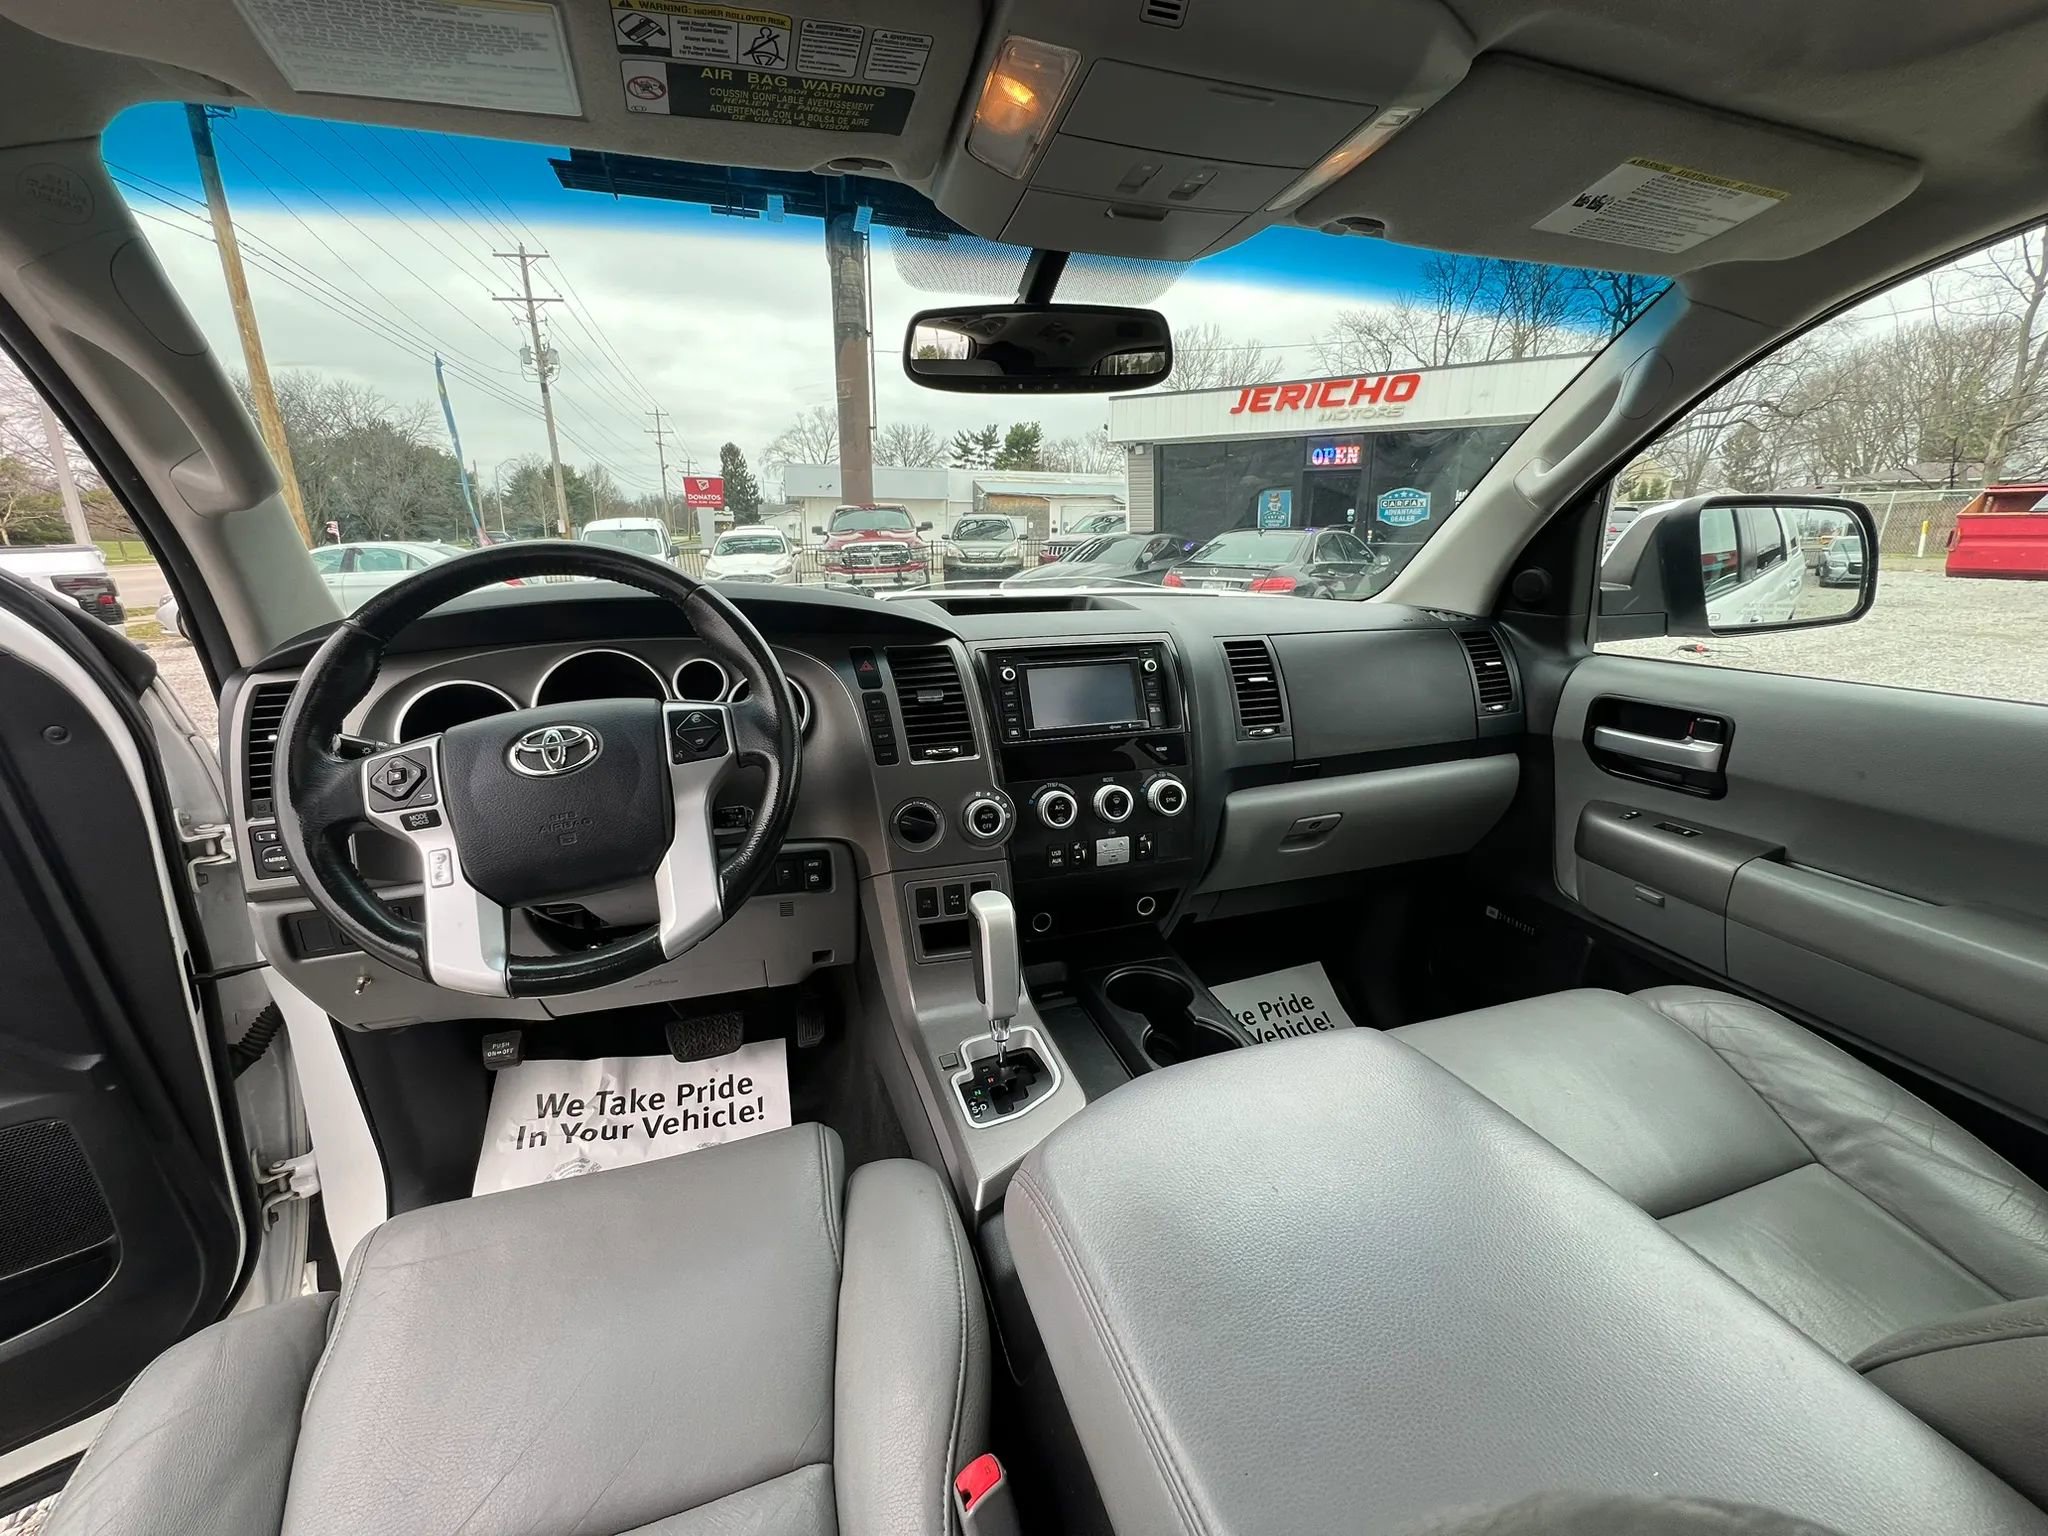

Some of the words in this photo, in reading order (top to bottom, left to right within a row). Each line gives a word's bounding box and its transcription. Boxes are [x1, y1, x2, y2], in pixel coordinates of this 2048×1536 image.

[638, 0, 692, 14] WARNING:
[693, 8, 724, 18] HIGHER
[725, 11, 766, 24] ROLLOVER
[768, 15, 787, 27] RISK
[700, 67, 733, 81] AIR
[747, 72, 788, 87] BAG
[802, 78, 886, 97] WARNING
[750, 84, 771, 92] FLIP
[777, 86, 808, 96] VISOR
[709, 87, 749, 98] COUSSIN
[752, 91, 804, 105] GONFLABLE
[807, 97, 874, 111] AVERTISSEMENT
[722, 97, 769, 107] REPLIER
[776, 101, 790, 109] LE
[709, 103, 770, 117] ADVERTENCIA
[772, 109, 788, 119] CON
[793, 111, 805, 121] LA
[807, 113, 834, 125] BOLSA
[837, 116, 849, 126] DE
[850, 117, 871, 128] AIRE
[753, 115, 793, 127] VUELTA
[799, 120, 814, 129] AL
[819, 122, 850, 132] VISOR
[1230, 373, 1422, 416] JERICHO
[1318, 405, 1406, 424] MOTORS
[1311, 444, 1361, 466] OPEN
[687, 494, 722, 502] DONATOS
[1381, 499, 1426, 508] CARFAX
[1384, 508, 1422, 516] ADVANTAGE
[1390, 515, 1415, 523] DEALER
[409, 812, 428, 822] MODE
[1257, 993, 1316, 1022] Pride
[1251, 1010, 1336, 1044] Vehicle!
[492, 1041, 511, 1050] PUSH
[536, 1091, 585, 1120] We
[596, 1087, 666, 1116] Take
[677, 1073, 754, 1107] Pride
[515, 1125, 549, 1150] In
[560, 1121, 635, 1145] Your
[642, 1096, 766, 1140] Vehicle!
